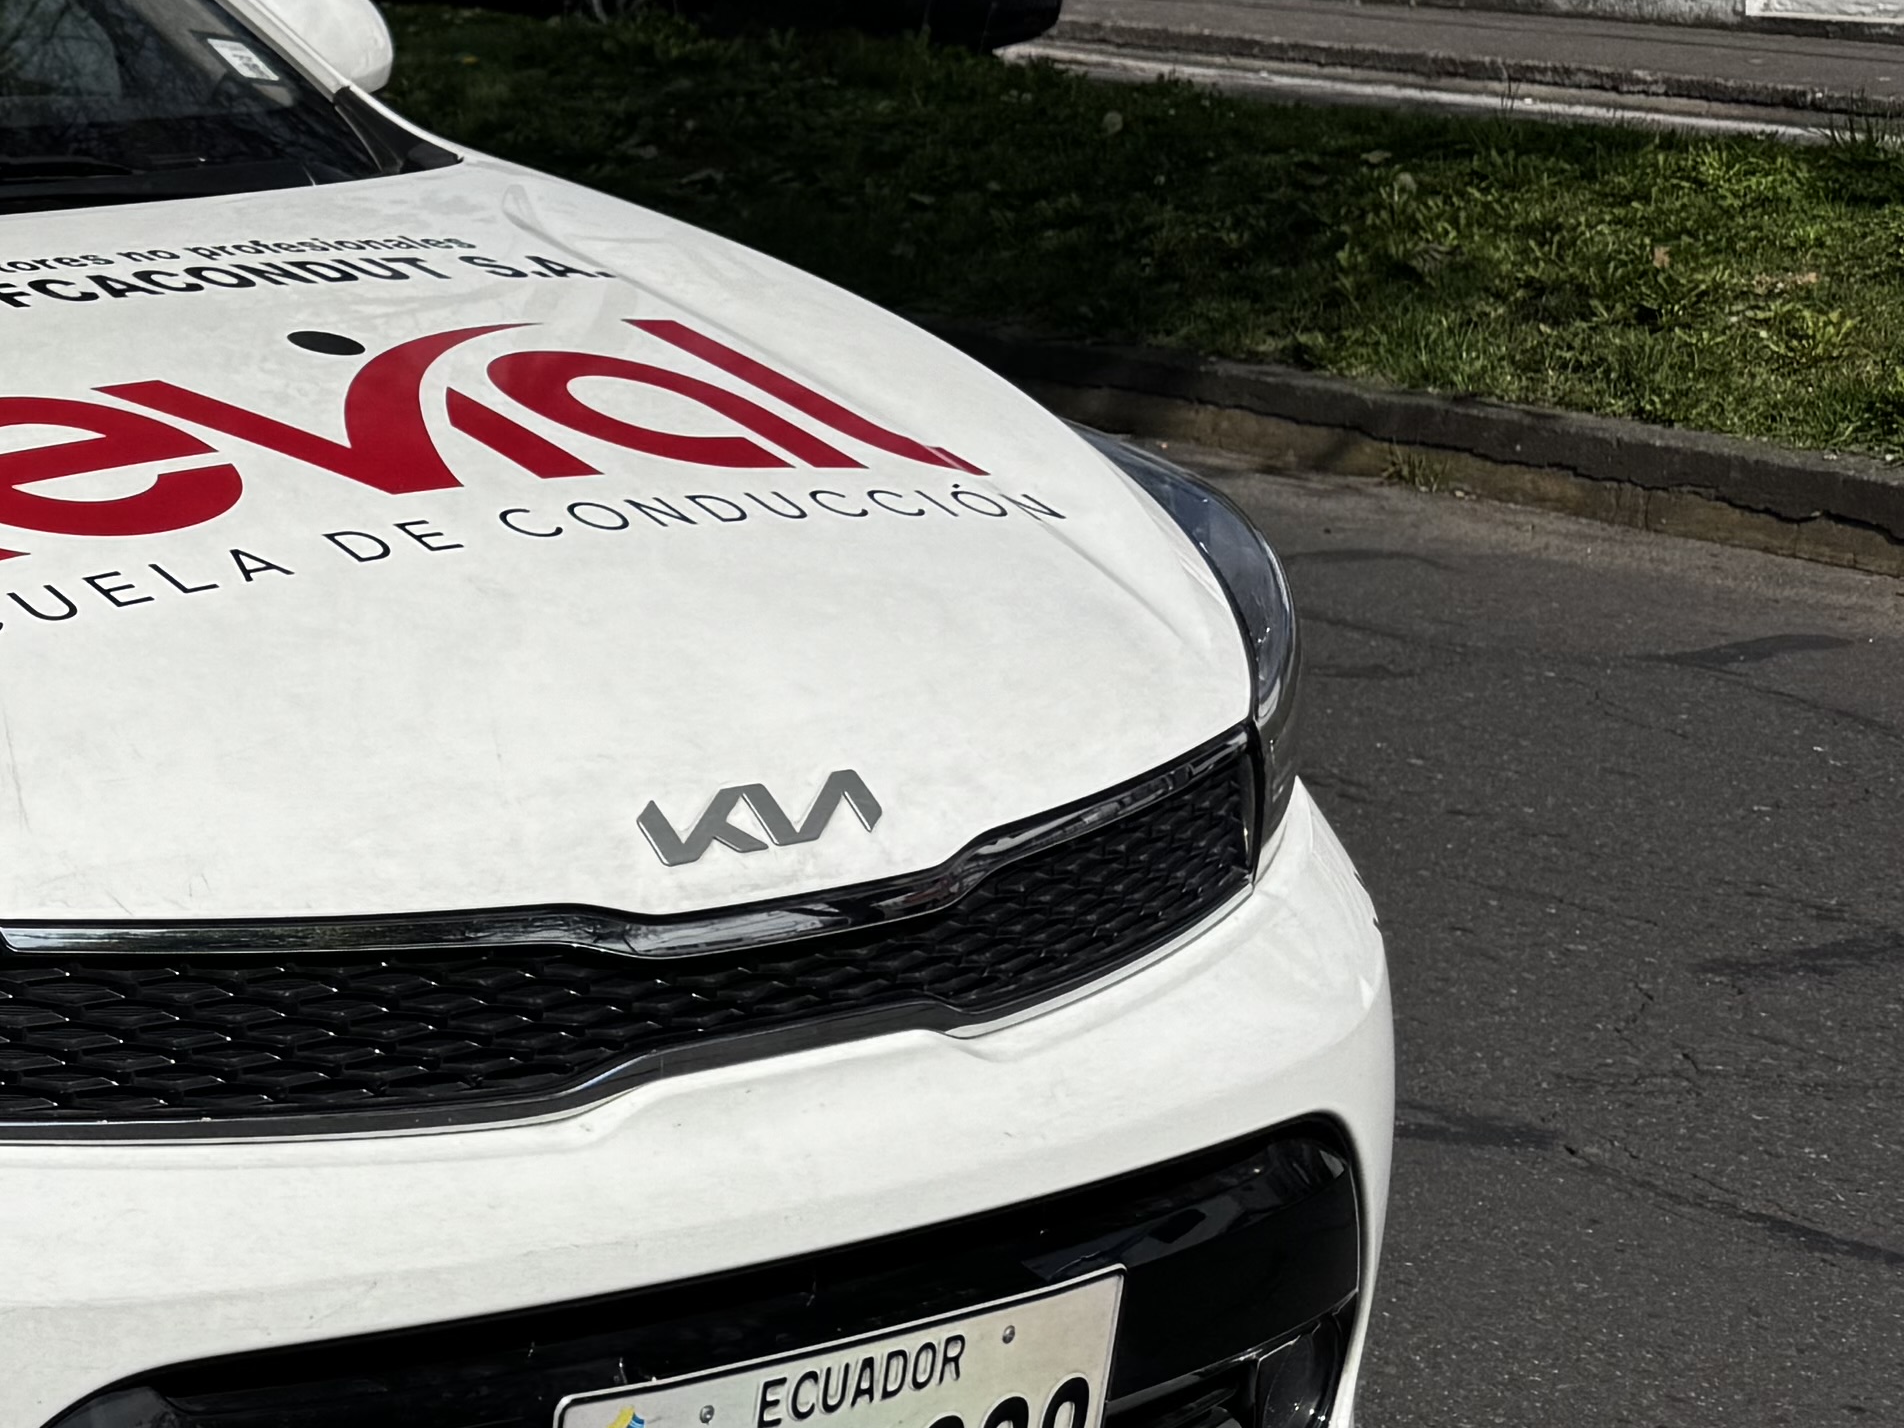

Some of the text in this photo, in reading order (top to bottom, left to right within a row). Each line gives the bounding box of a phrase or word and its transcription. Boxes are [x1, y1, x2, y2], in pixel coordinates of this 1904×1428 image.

[116, 246, 181, 263] no
[185, 233, 478, 260] profesionales
[463, 254, 618, 280] S.A.
[321, 518, 468, 565] DE
[498, 480, 1067, 541] CONDUCCIÓN
[635, 768, 884, 868] KIA
